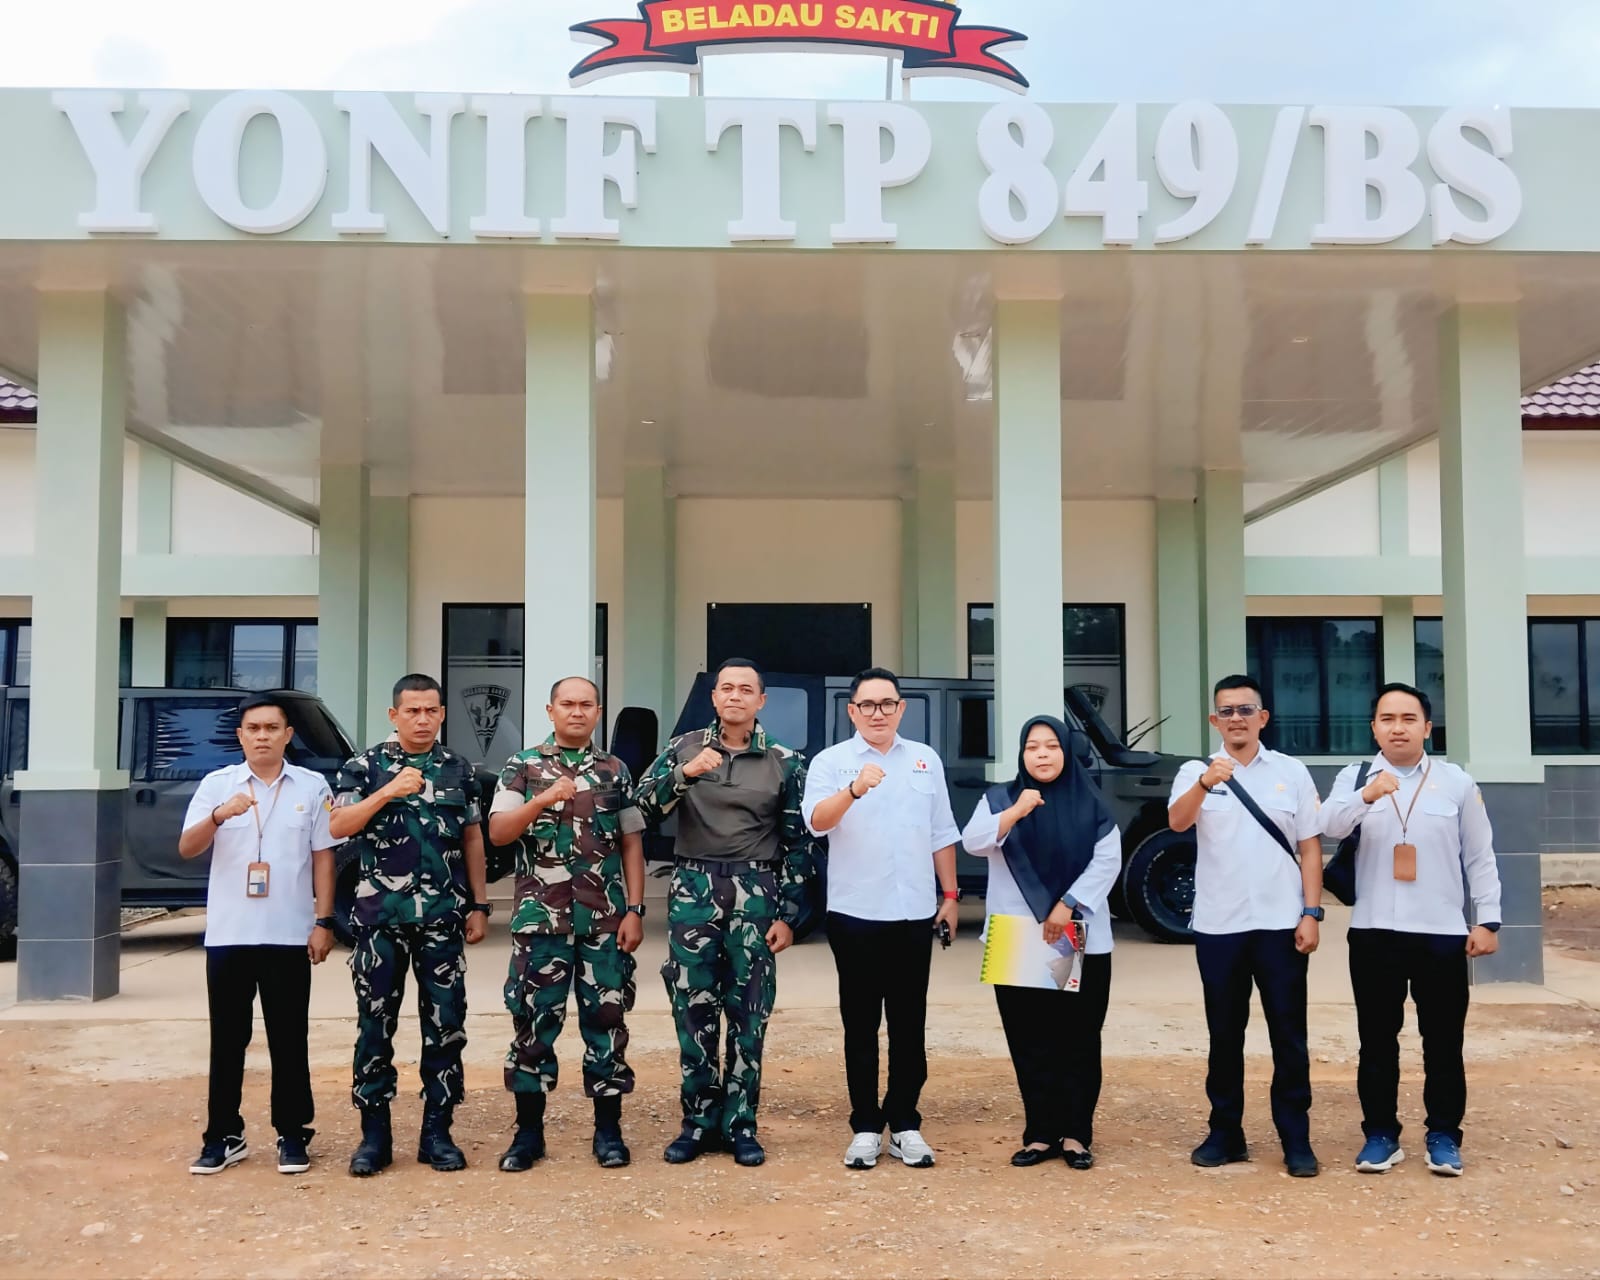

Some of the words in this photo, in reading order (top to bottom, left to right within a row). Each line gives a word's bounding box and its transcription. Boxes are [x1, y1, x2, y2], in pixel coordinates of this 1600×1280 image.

[661, 4, 823, 33] BELADAU
[835, 5, 939, 39] SAKTI
[51, 88, 656, 241] YONIF
[705, 99, 932, 243] TP
[977, 99, 1522, 246] 849/BS
